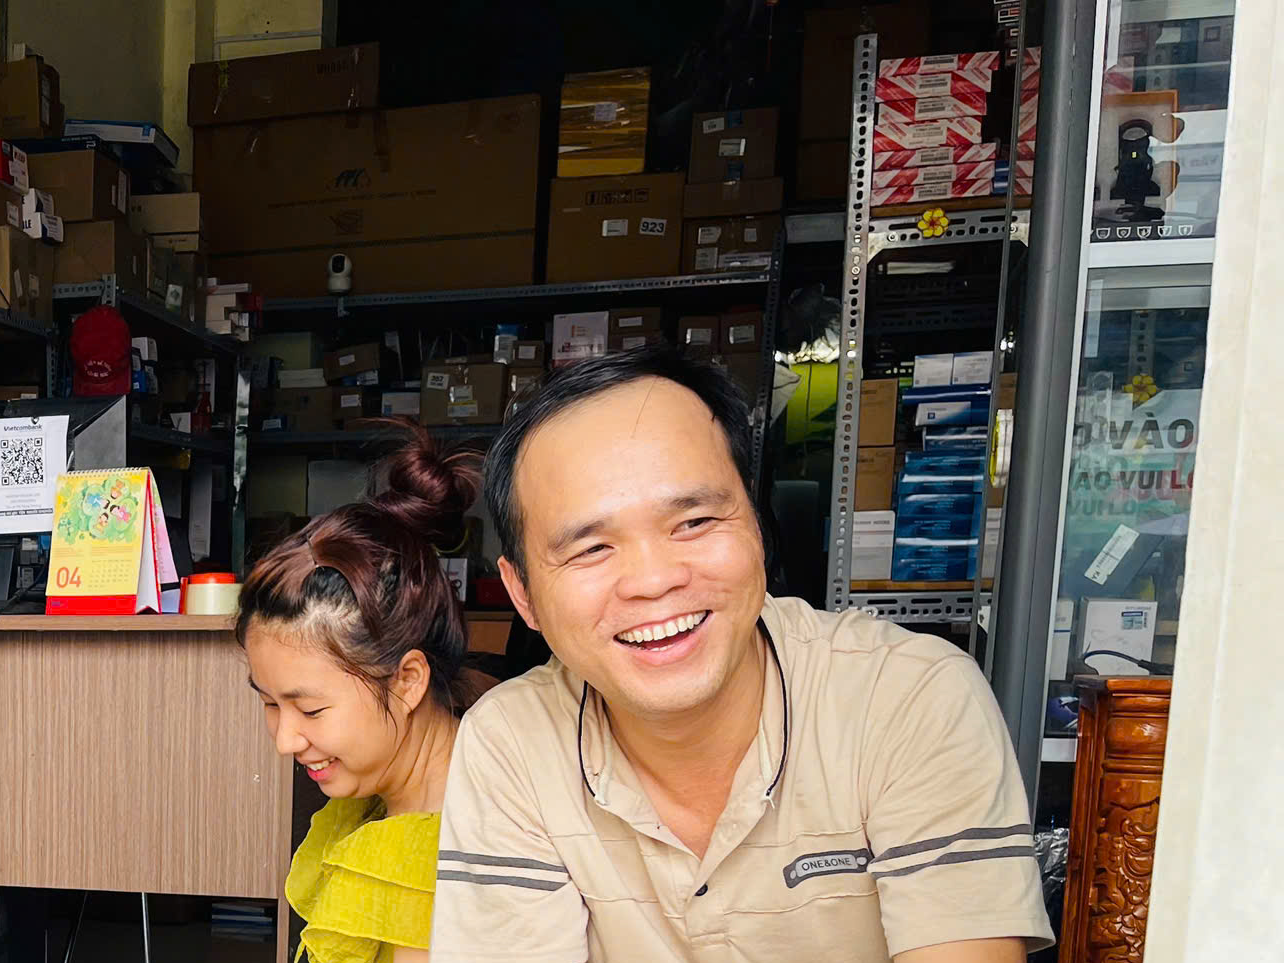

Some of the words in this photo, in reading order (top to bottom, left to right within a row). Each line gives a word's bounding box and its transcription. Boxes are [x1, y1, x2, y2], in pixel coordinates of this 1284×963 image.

[641, 221, 665, 233] 923
[56, 566, 82, 589] 04
[801, 857, 852, 871] ONE&ONE
